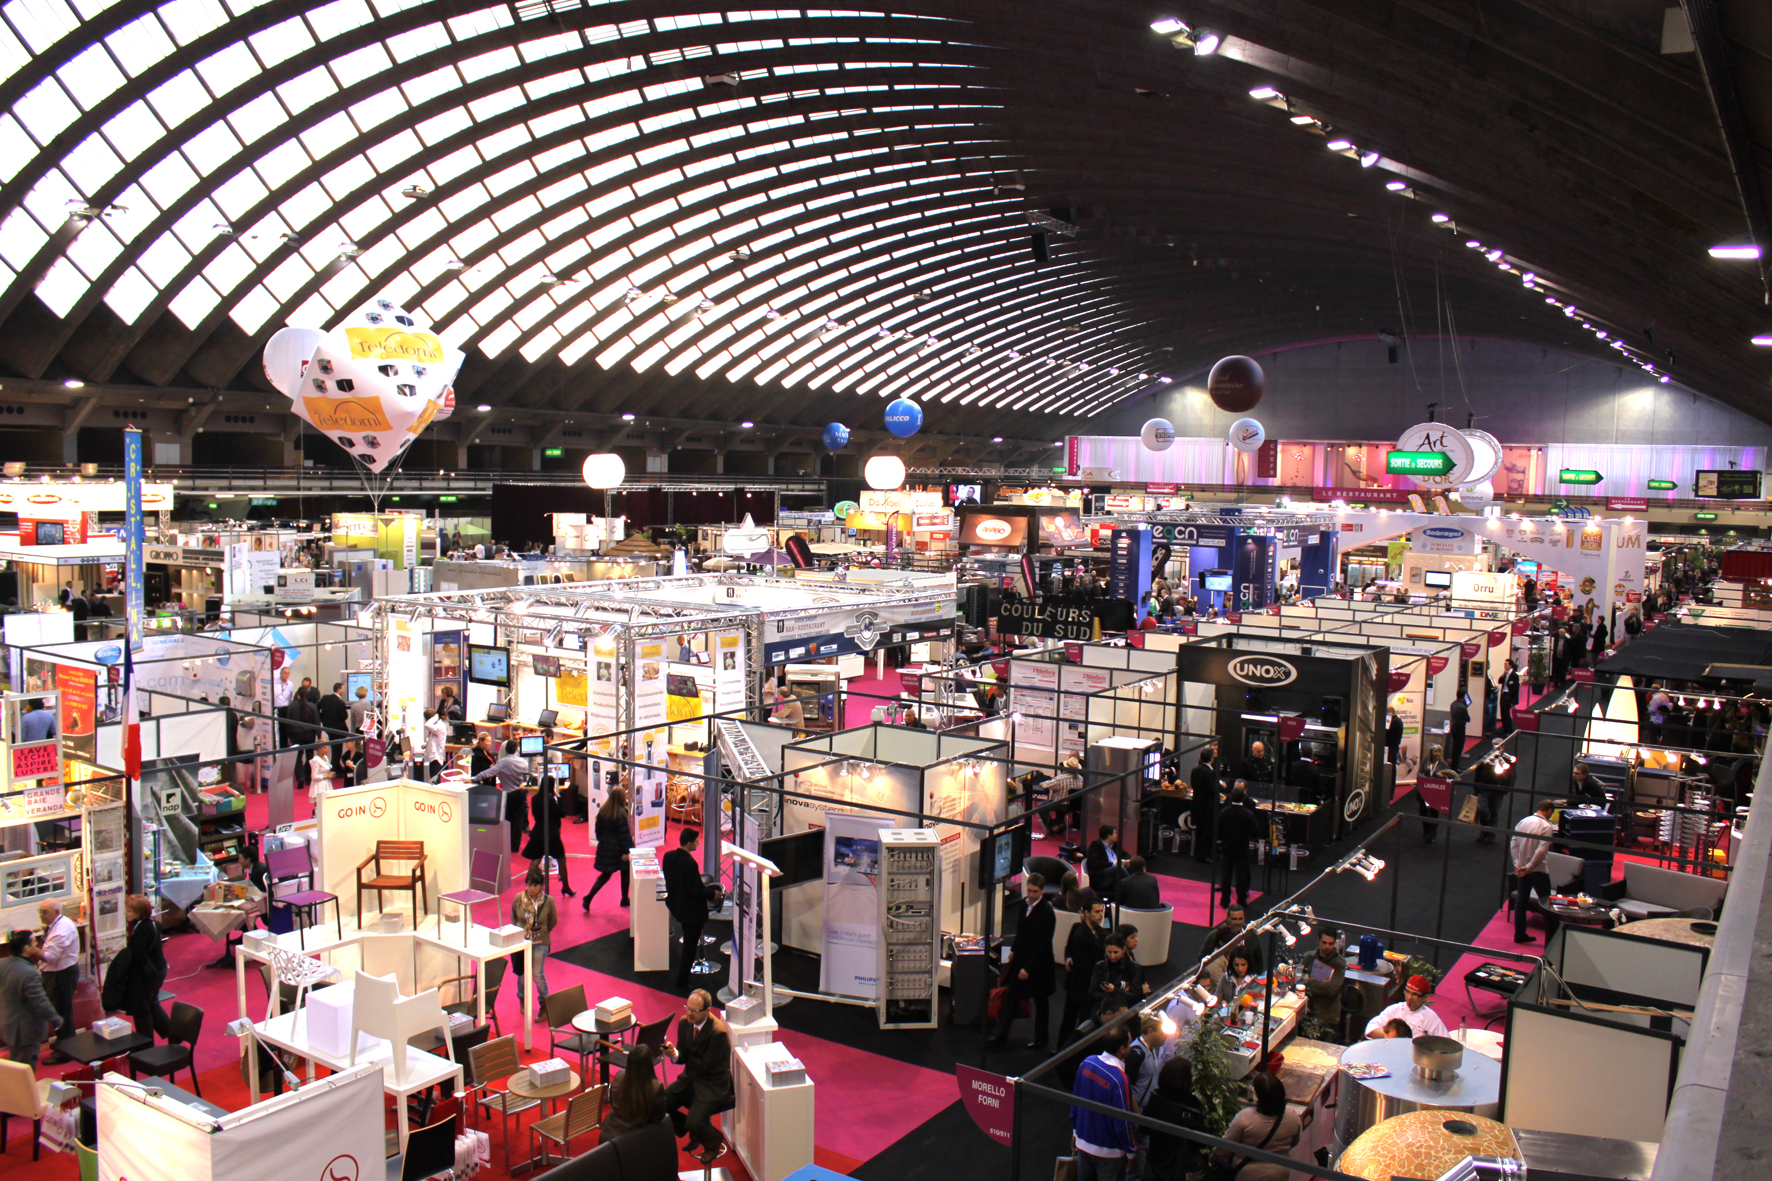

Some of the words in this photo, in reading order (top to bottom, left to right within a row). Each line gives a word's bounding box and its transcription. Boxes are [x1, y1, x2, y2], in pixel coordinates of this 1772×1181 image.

[354, 340, 437, 359] Teledom
[314, 410, 381, 427] Teledom
[1416, 431, 1448, 452] Art
[1390, 458, 1410, 468] SORTIE
[1416, 458, 1443, 469] SECOURS
[1336, 491, 1398, 499] RESTAURANT
[1152, 525, 1198, 542] egcn
[1425, 529, 1462, 538] Sobragel
[1582, 534, 1601, 543] CARTE
[129, 444, 140, 642] CRISTALLINA
[150, 549, 179, 561] GROPPO
[1473, 583, 1494, 593] Orru
[1001, 603, 1092, 623] COULEURS
[785, 621, 826, 633] BAR-RESTAURANT
[1021, 621, 1043, 636] DU
[1054, 624, 1090, 640] SUD
[1236, 662, 1286, 680] UNOX
[17, 752, 52, 762] SECHE
[20, 746, 49, 756] LAVE
[16, 759, 52, 769] ASPIRE
[15, 765, 56, 777] LUSTRE
[1423, 782, 1446, 791] LAURALEE
[26, 787, 62, 799] GRANDE
[26, 797, 48, 806] BAIE
[25, 803, 64, 816] VERANDA
[162, 804, 180, 813] nap
[337, 807, 354, 819] GO
[355, 805, 366, 816] IN
[414, 801, 426, 812] GO
[427, 803, 436, 815] IN
[96, 886, 123, 897] nice-matin
[840, 929, 856, 937] today's
[854, 975, 877, 983] PHILIPS
[971, 1079, 1006, 1097] MORELLO
[977, 1094, 1000, 1109] FORNI
